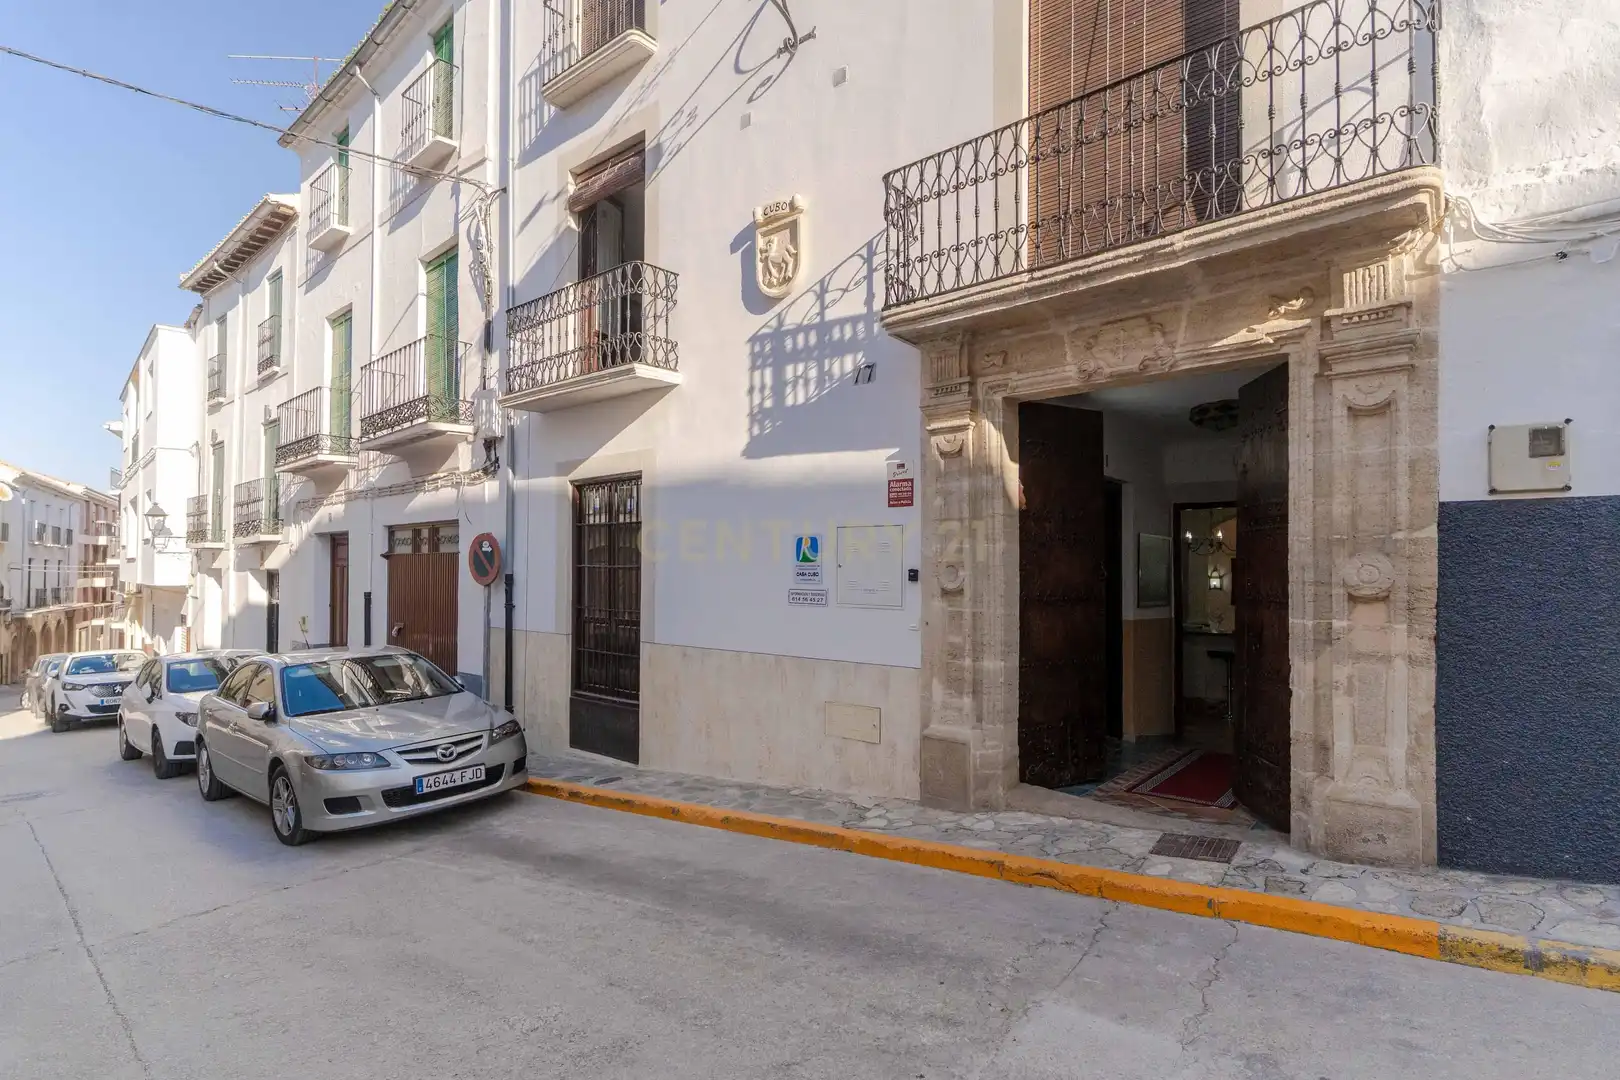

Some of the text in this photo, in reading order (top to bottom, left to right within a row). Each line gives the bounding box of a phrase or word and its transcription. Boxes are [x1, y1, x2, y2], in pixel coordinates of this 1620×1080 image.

[763, 201, 788, 216] CUBO
[889, 480, 912, 488] Alarma
[425, 767, 483, 789] 4644 FJD
